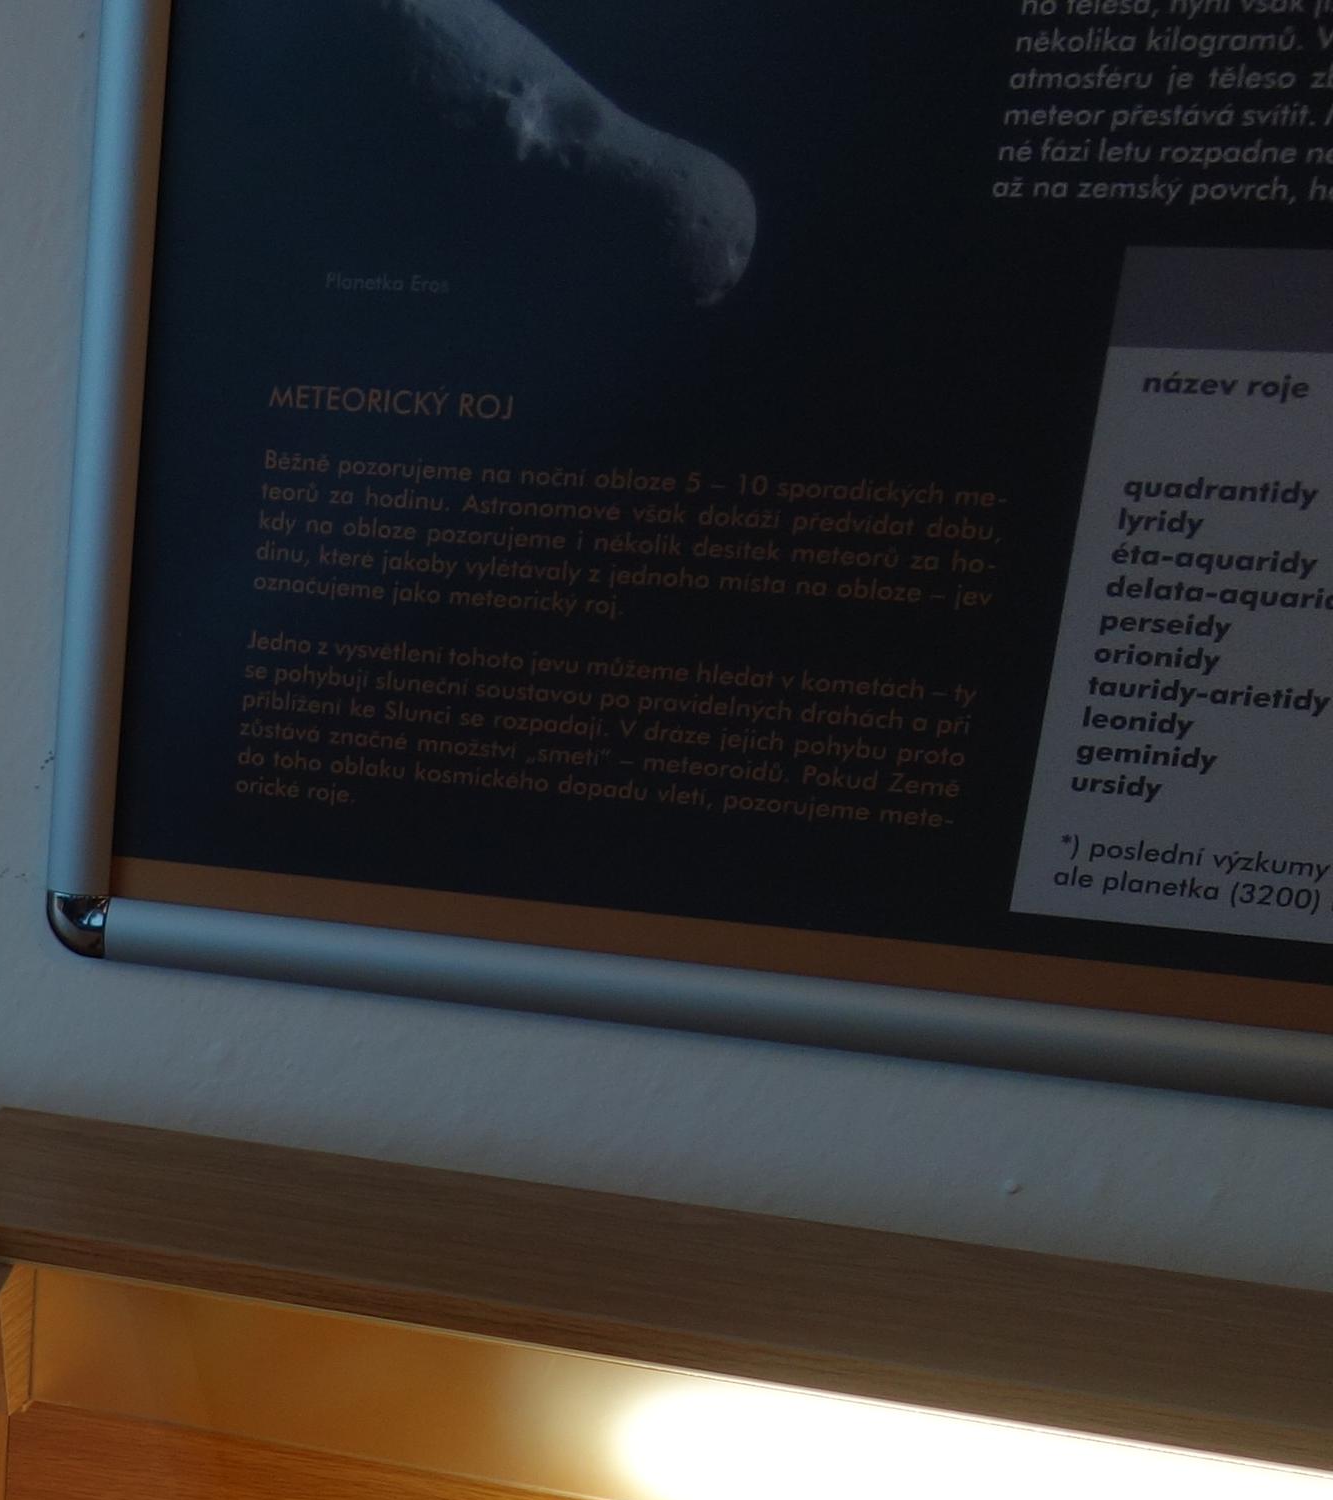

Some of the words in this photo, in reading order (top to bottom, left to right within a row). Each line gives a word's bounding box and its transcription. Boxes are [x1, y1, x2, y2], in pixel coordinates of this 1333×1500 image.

[1015, 25, 1137, 53] několika
[1146, 25, 1305, 58] kilogramů.
[1008, 64, 1153, 90] atmosféru
[1165, 64, 1194, 95] je
[1208, 62, 1297, 90] těleso
[1002, 104, 1106, 127] meteor
[1109, 104, 1234, 132] přestává
[997, 140, 1033, 163] né
[1040, 137, 1091, 163] fázi
[1097, 137, 1152, 164] letu
[1159, 137, 1298, 170] rozpadne
[991, 176, 1025, 199] až
[1032, 180, 1069, 199] na
[1076, 173, 1184, 206] zemský
[1189, 175, 1297, 206] povrch,
[267, 383, 450, 417] METEORICKÝ
[458, 392, 516, 421] ROJ
[1141, 371, 1239, 396] název
[1246, 374, 1310, 404] roje
[263, 448, 331, 474] Běžně
[337, 459, 473, 485] pozorujeme
[481, 468, 511, 485] na
[520, 468, 587, 489] noční
[595, 466, 677, 494] obloze
[685, 471, 702, 494] 5
[738, 472, 769, 497] 10
[775, 477, 945, 509] sporadických
[954, 487, 1008, 508] me-
[1123, 476, 1320, 511] quadrantidy
[1117, 507, 1205, 540] lyridy
[1110, 541, 1319, 580] éta-aquaridy
[1099, 613, 1233, 644] perseidy
[1093, 643, 1221, 676] orionidy
[1088, 676, 1332, 717] tauridy-arietidy
[1082, 705, 1195, 741] leonidy
[1075, 744, 1219, 775] geminidy
[1070, 774, 1163, 803] ursidy
[1088, 839, 1206, 867] poslední
[1212, 849, 1332, 883] výzkumy
[1053, 865, 1094, 888] ale
[1101, 870, 1220, 901] planetka
[1229, 881, 1321, 916] (3200)
